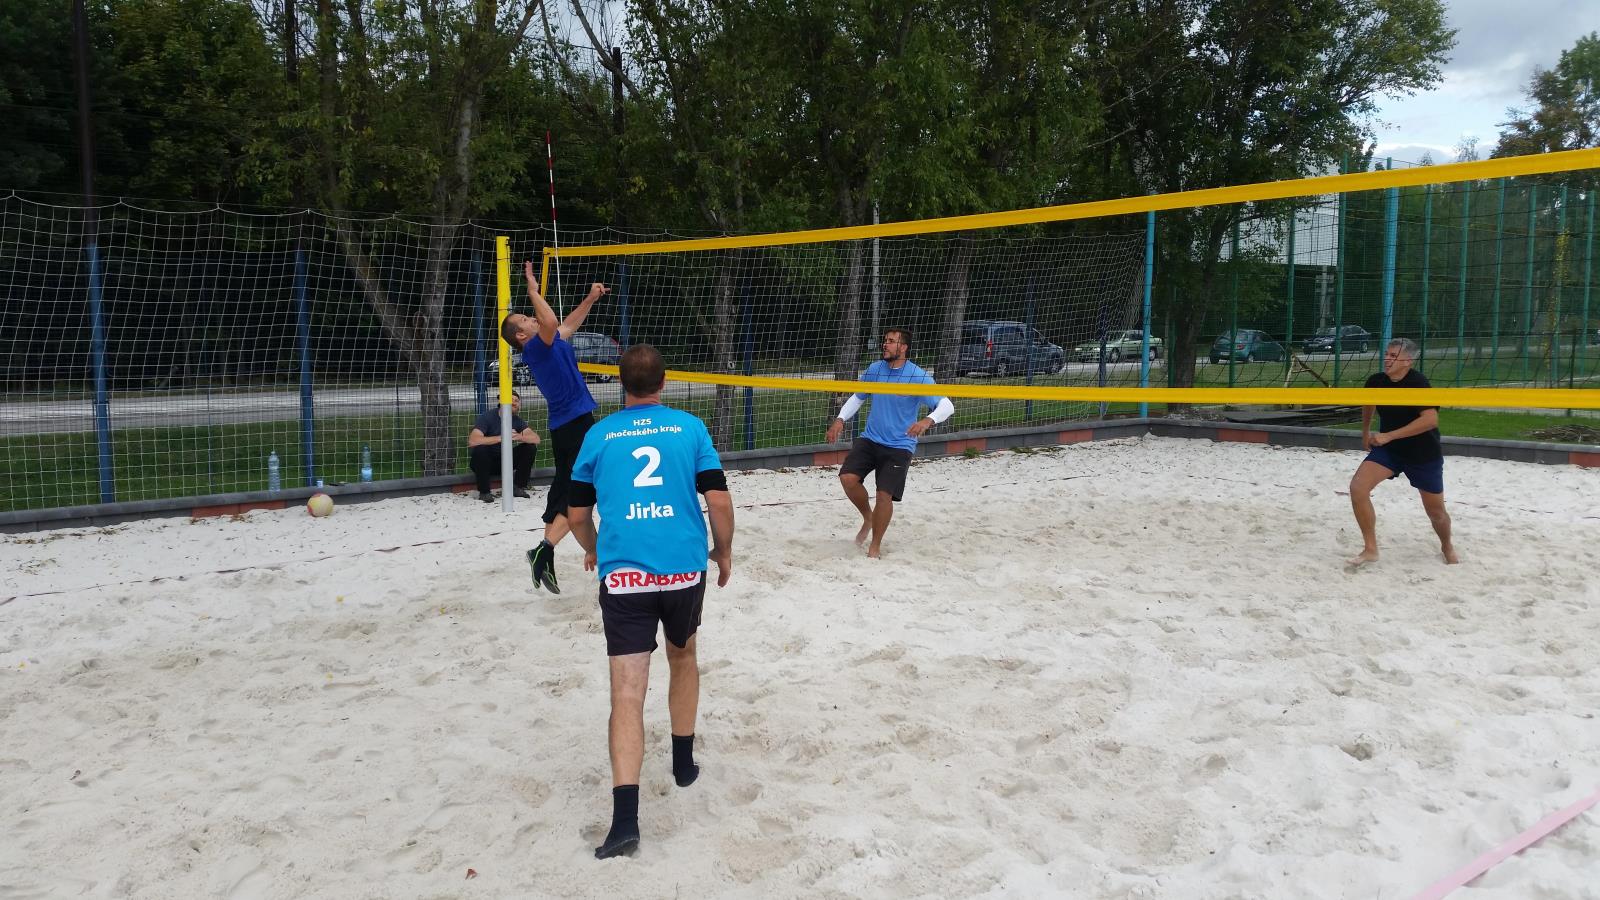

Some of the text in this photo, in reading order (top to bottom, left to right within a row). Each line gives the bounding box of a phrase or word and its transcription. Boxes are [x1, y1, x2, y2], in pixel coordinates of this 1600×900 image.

[633, 418, 652, 427] HZS
[604, 424, 682, 441] Jihočeského kraje
[631, 445, 664, 488] 2
[625, 502, 675, 520] Jirka
